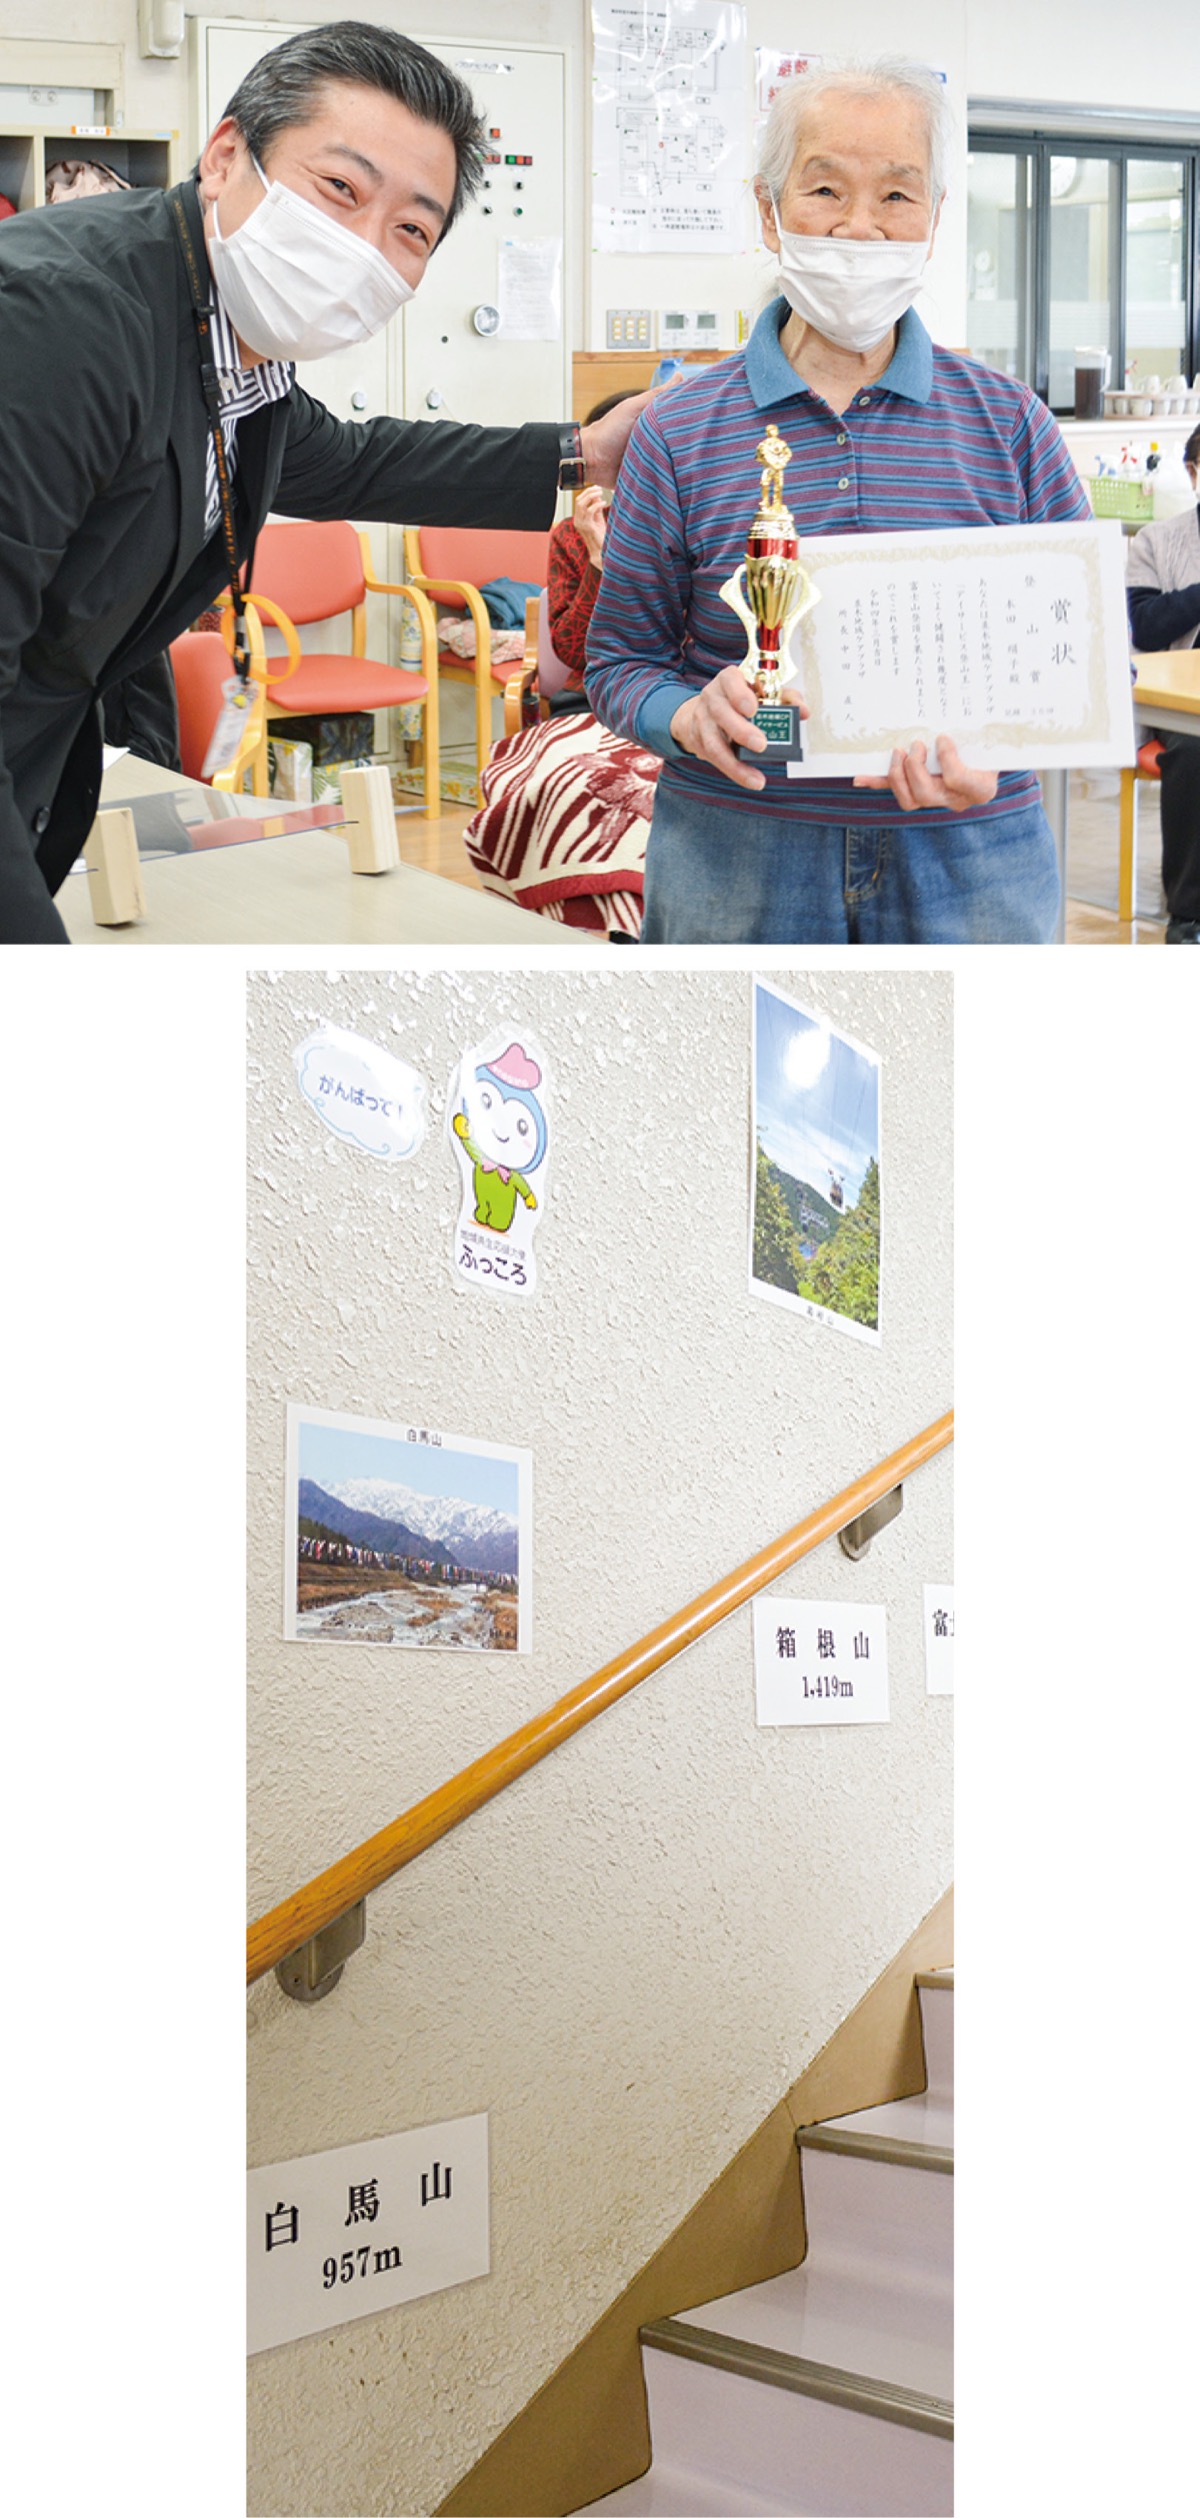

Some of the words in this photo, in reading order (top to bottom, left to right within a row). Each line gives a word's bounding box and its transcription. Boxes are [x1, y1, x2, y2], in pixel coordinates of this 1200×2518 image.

[1050, 598, 1077, 666] 賞状
[458, 1243, 528, 1287] ふっころ
[406, 1427, 443, 1448] 白馬山
[775, 1625, 871, 1660] 箱根山
[264, 2160, 453, 2253] 白馬山
[321, 2244, 403, 2290] 957m
